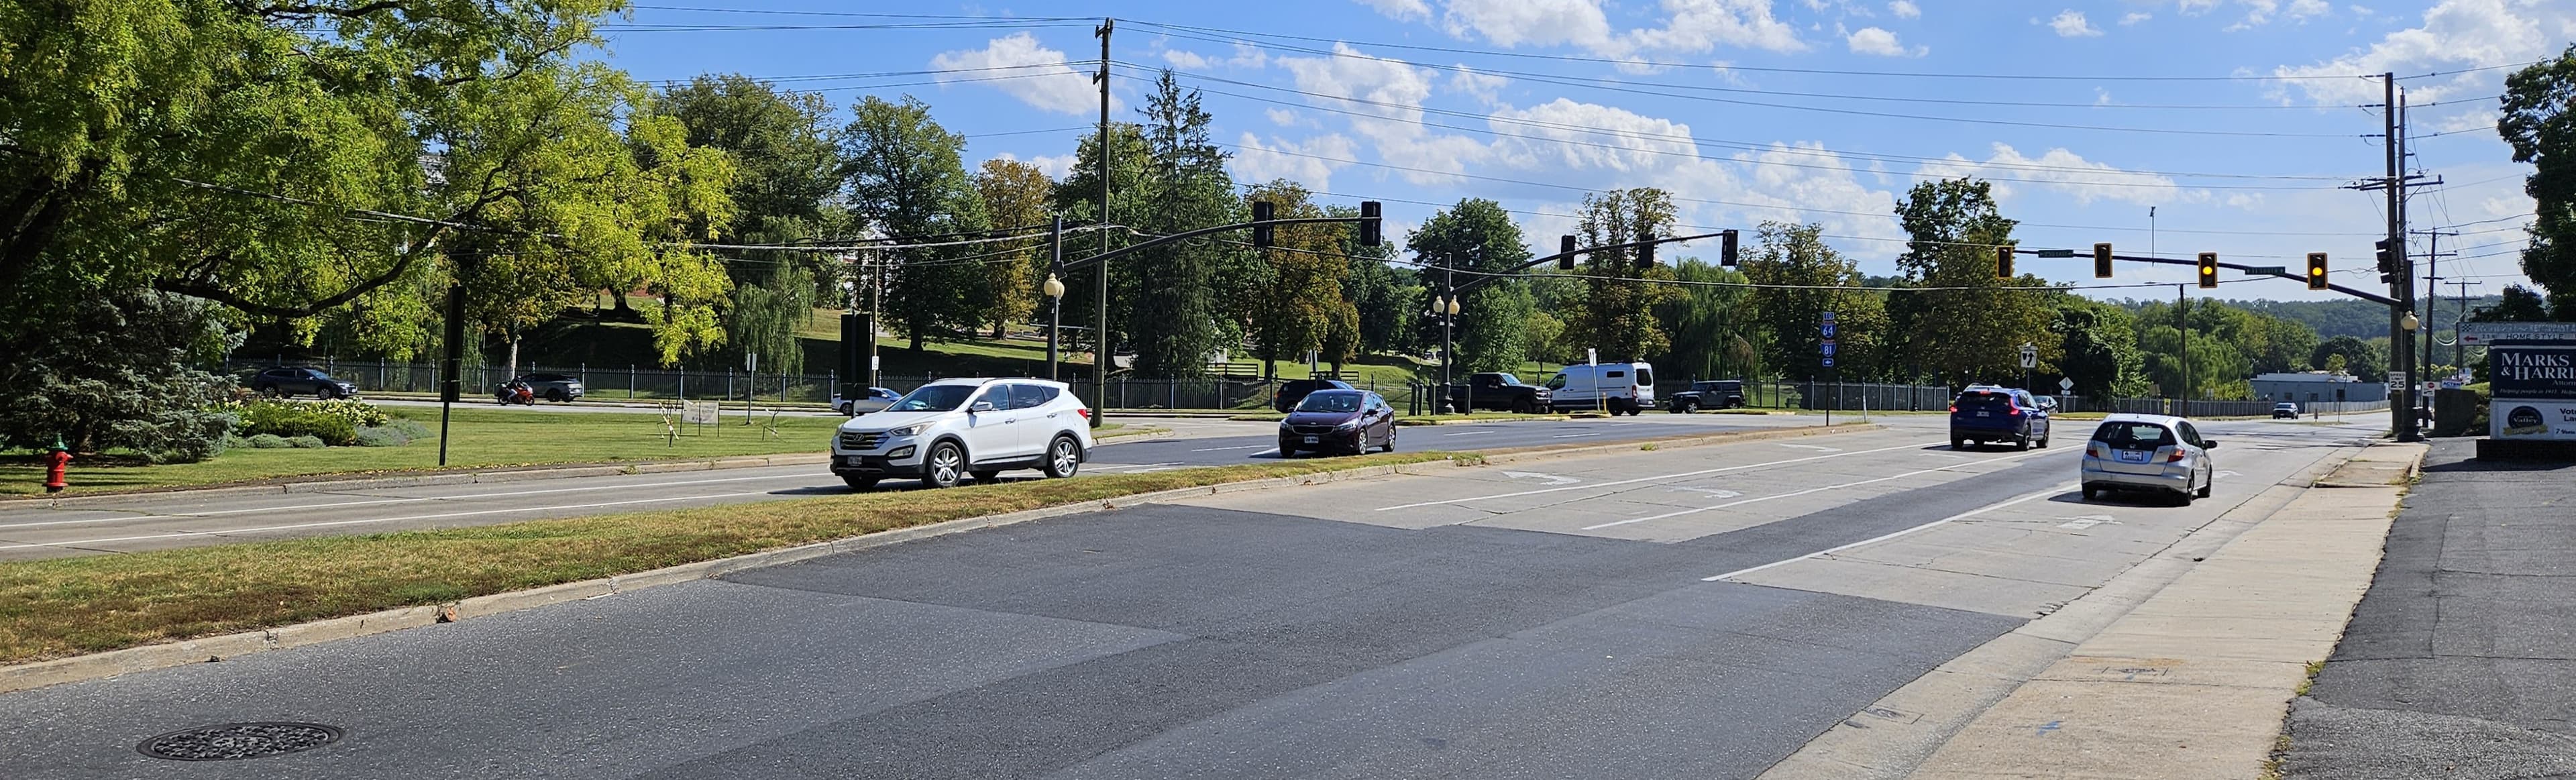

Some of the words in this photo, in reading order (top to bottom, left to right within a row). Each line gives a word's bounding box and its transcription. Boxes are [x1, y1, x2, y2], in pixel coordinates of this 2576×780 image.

[1823, 326, 1833, 335] 64
[1824, 345, 1832, 355] 81
[2501, 352, 2570, 367] MARKS
[2501, 366, 2511, 376] &
[2514, 366, 2576, 380] HARRI
